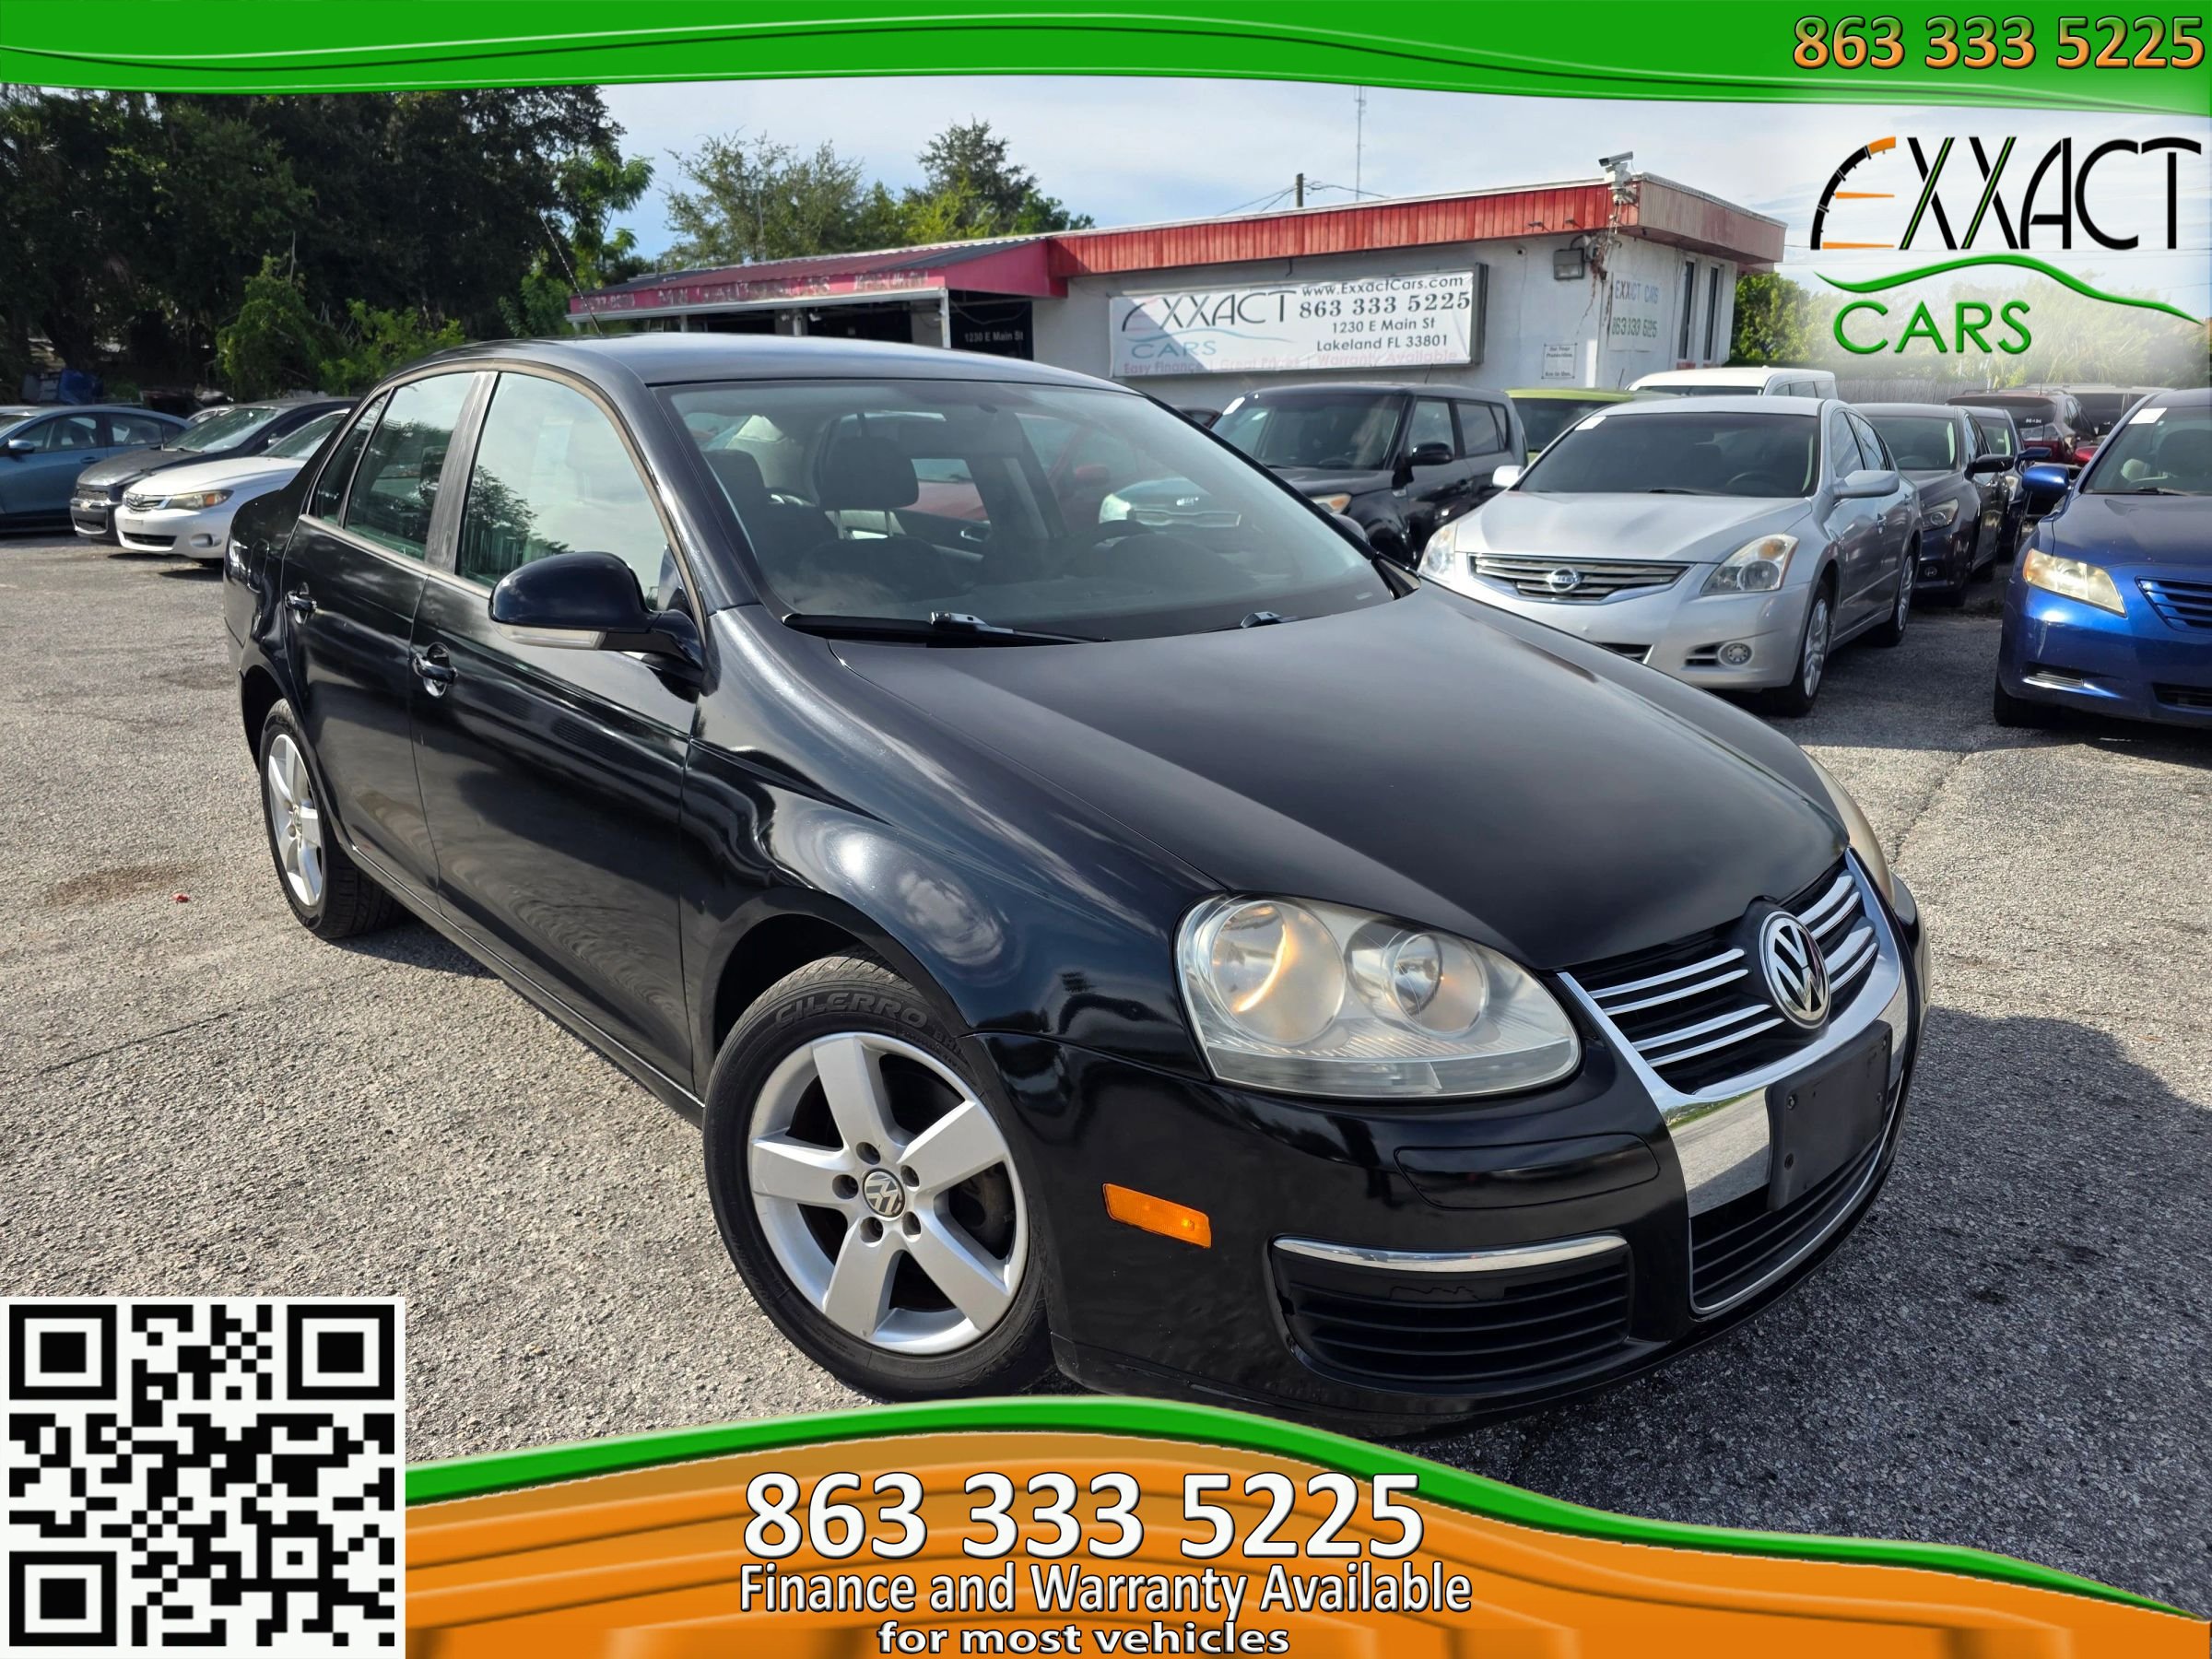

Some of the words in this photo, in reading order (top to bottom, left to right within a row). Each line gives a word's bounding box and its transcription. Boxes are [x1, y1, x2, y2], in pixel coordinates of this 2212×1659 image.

[1302, 276, 1464, 298] www.ExxactCars.com
[1300, 300, 1342, 319] 863
[1352, 296, 1396, 315] 333
[1407, 291, 1470, 312] 5225
[1332, 321, 1363, 334] 1230
[1369, 320, 1376, 332] E
[1381, 318, 1417, 331] Main
[1422, 317, 1435, 329] St
[1131, 340, 1217, 359] CARS
[1317, 336, 1382, 352] Lakeland
[1387, 336, 1401, 348] FL
[1406, 335, 1448, 347] 33801
[1124, 363, 1151, 375] Easy
[1318, 351, 1382, 367] Warranty
[1386, 348, 1458, 364] Available
